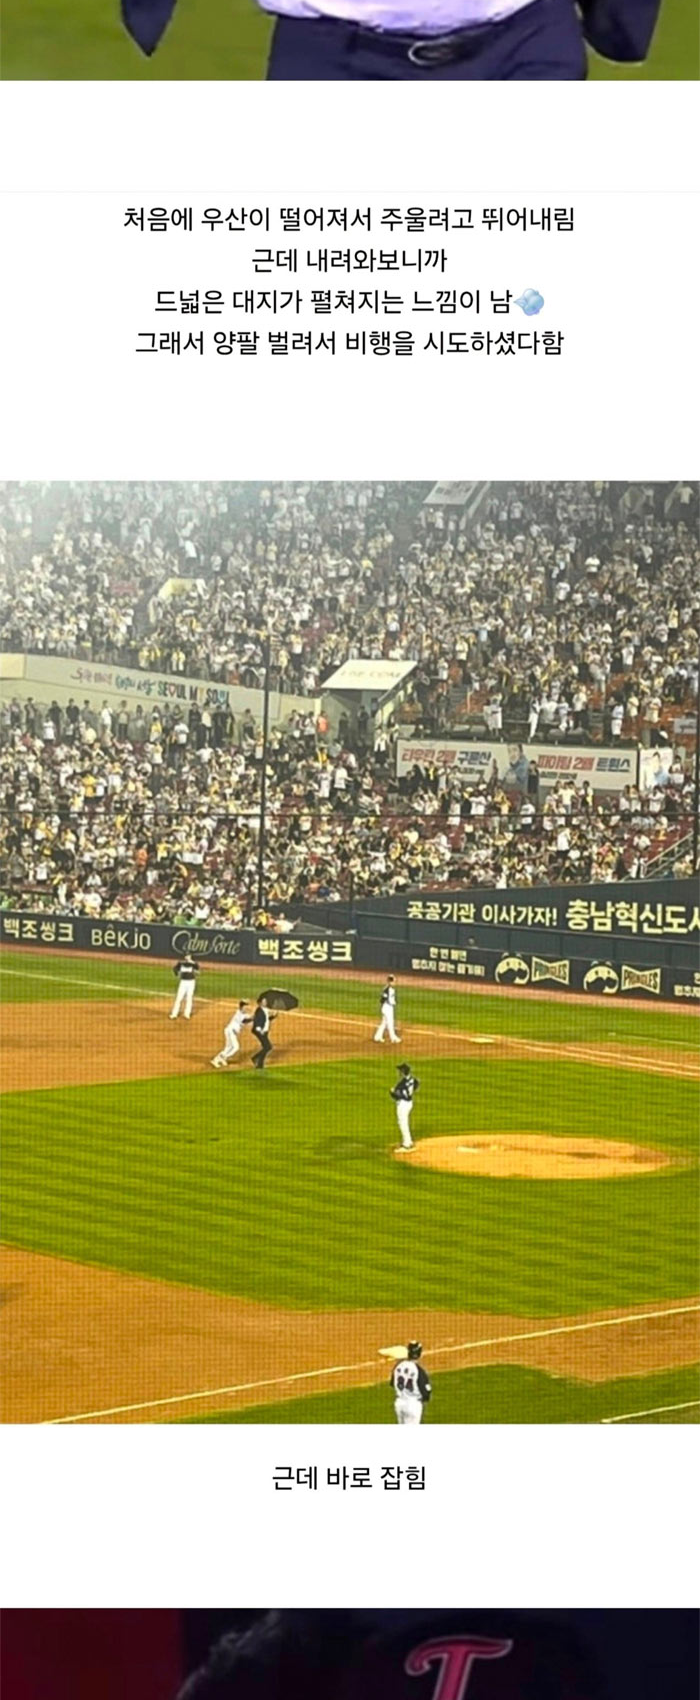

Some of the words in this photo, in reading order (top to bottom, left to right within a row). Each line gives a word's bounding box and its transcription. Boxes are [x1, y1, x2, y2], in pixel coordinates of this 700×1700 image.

[596, 757, 630, 773] 트윈스
[407, 900, 476, 924] 공공기관
[482, 904, 557, 927] 이사가자!
[3, 917, 74, 943] 백조씽크
[258, 938, 352, 962] 백조씽크
[623, 969, 658, 992] PRINGLES
